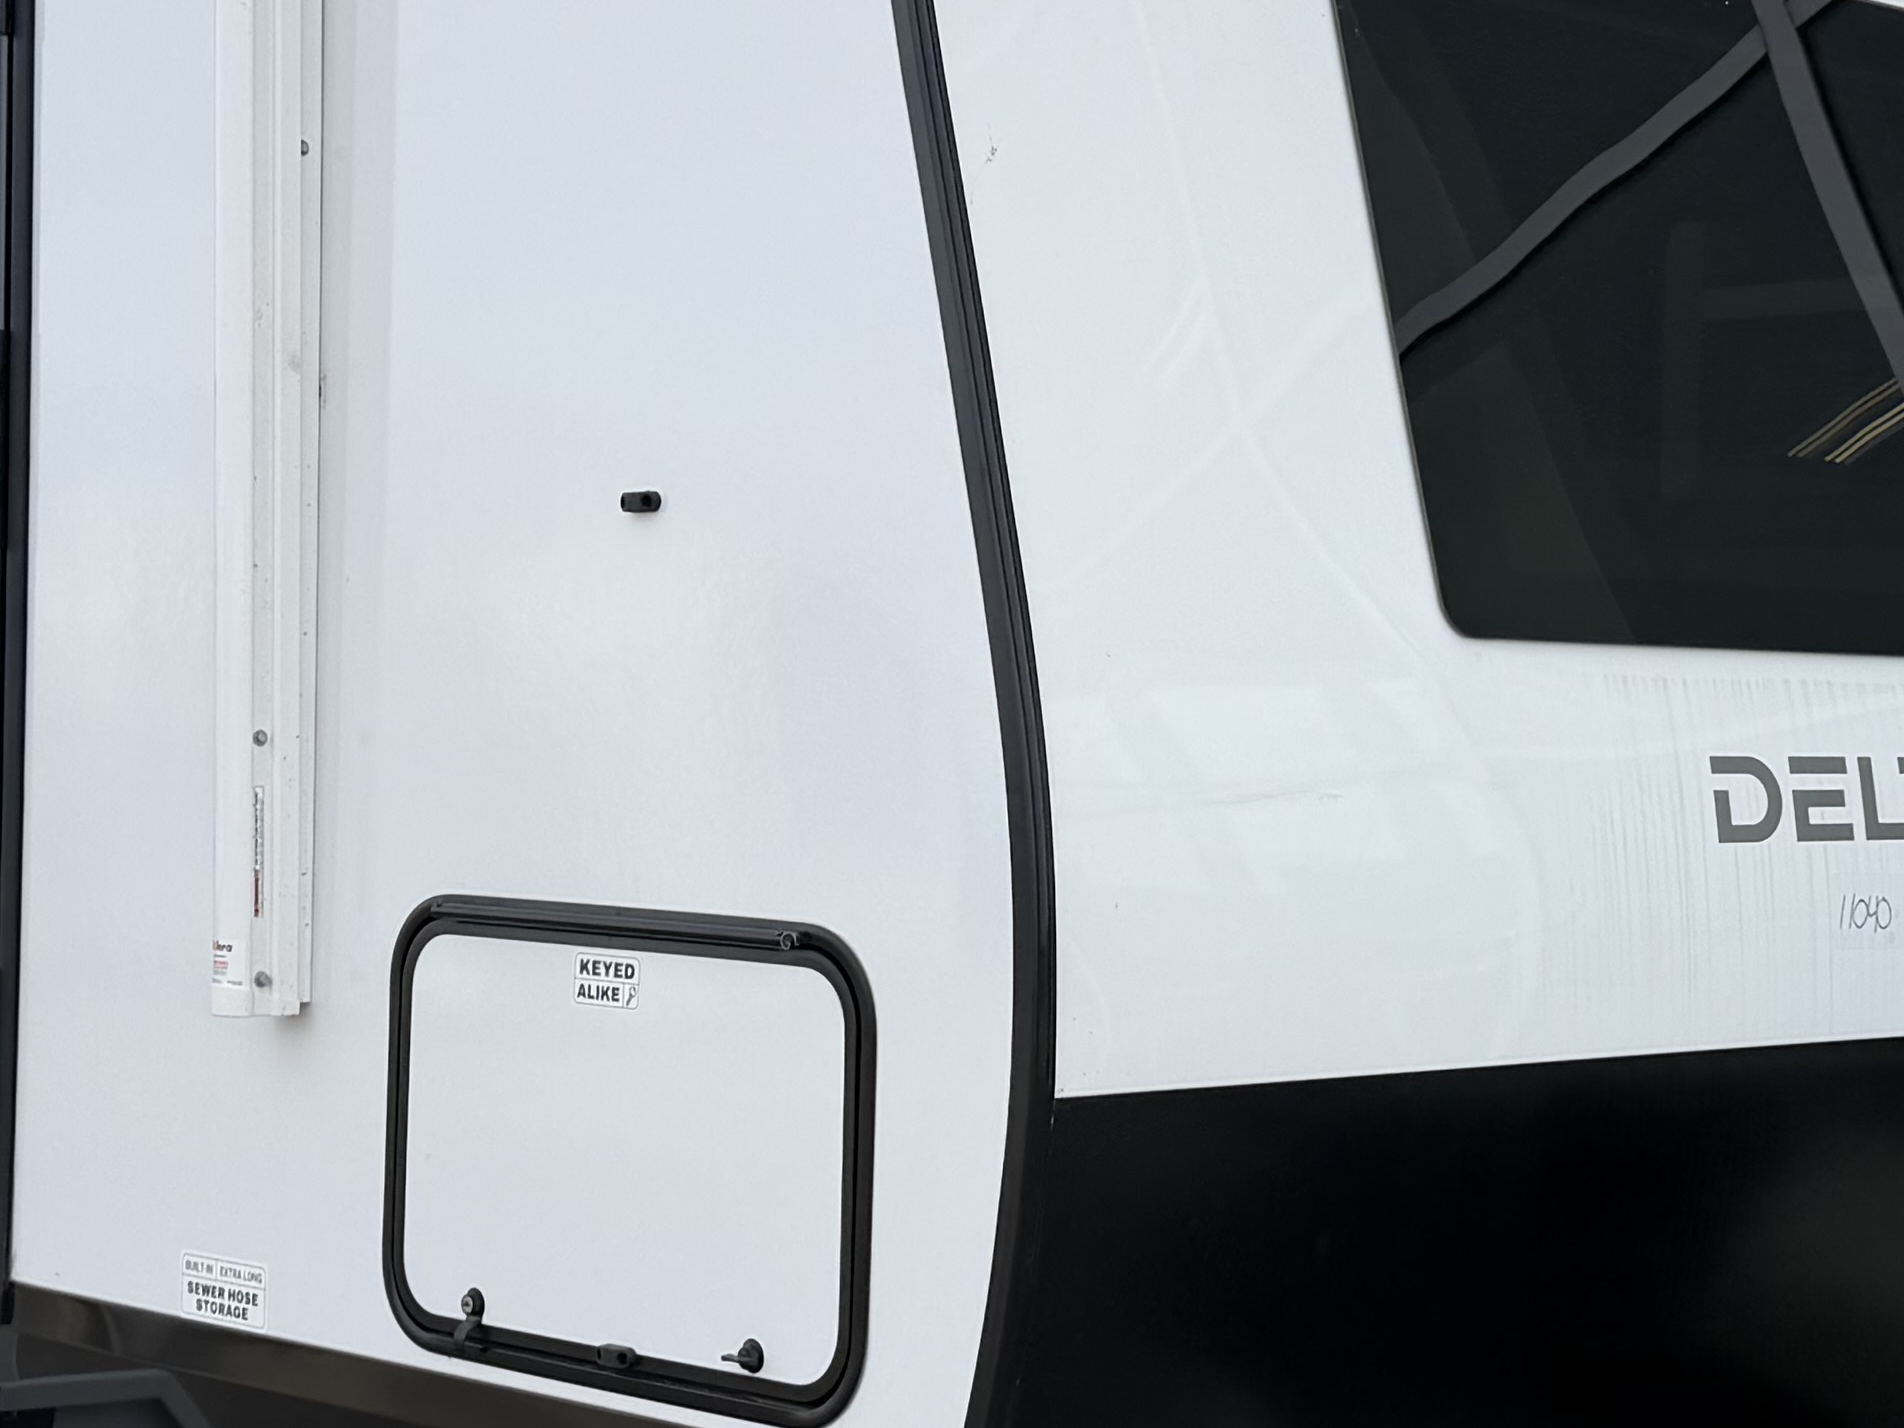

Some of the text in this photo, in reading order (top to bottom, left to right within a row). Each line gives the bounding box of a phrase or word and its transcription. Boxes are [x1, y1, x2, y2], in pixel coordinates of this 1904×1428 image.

[579, 958, 635, 980] KEYED
[577, 983, 620, 1003] ALIKE
[219, 1266, 242, 1280] EXTRA
[187, 1280, 259, 1307] SEWER HOSE
[195, 1298, 249, 1321] STORAGE
